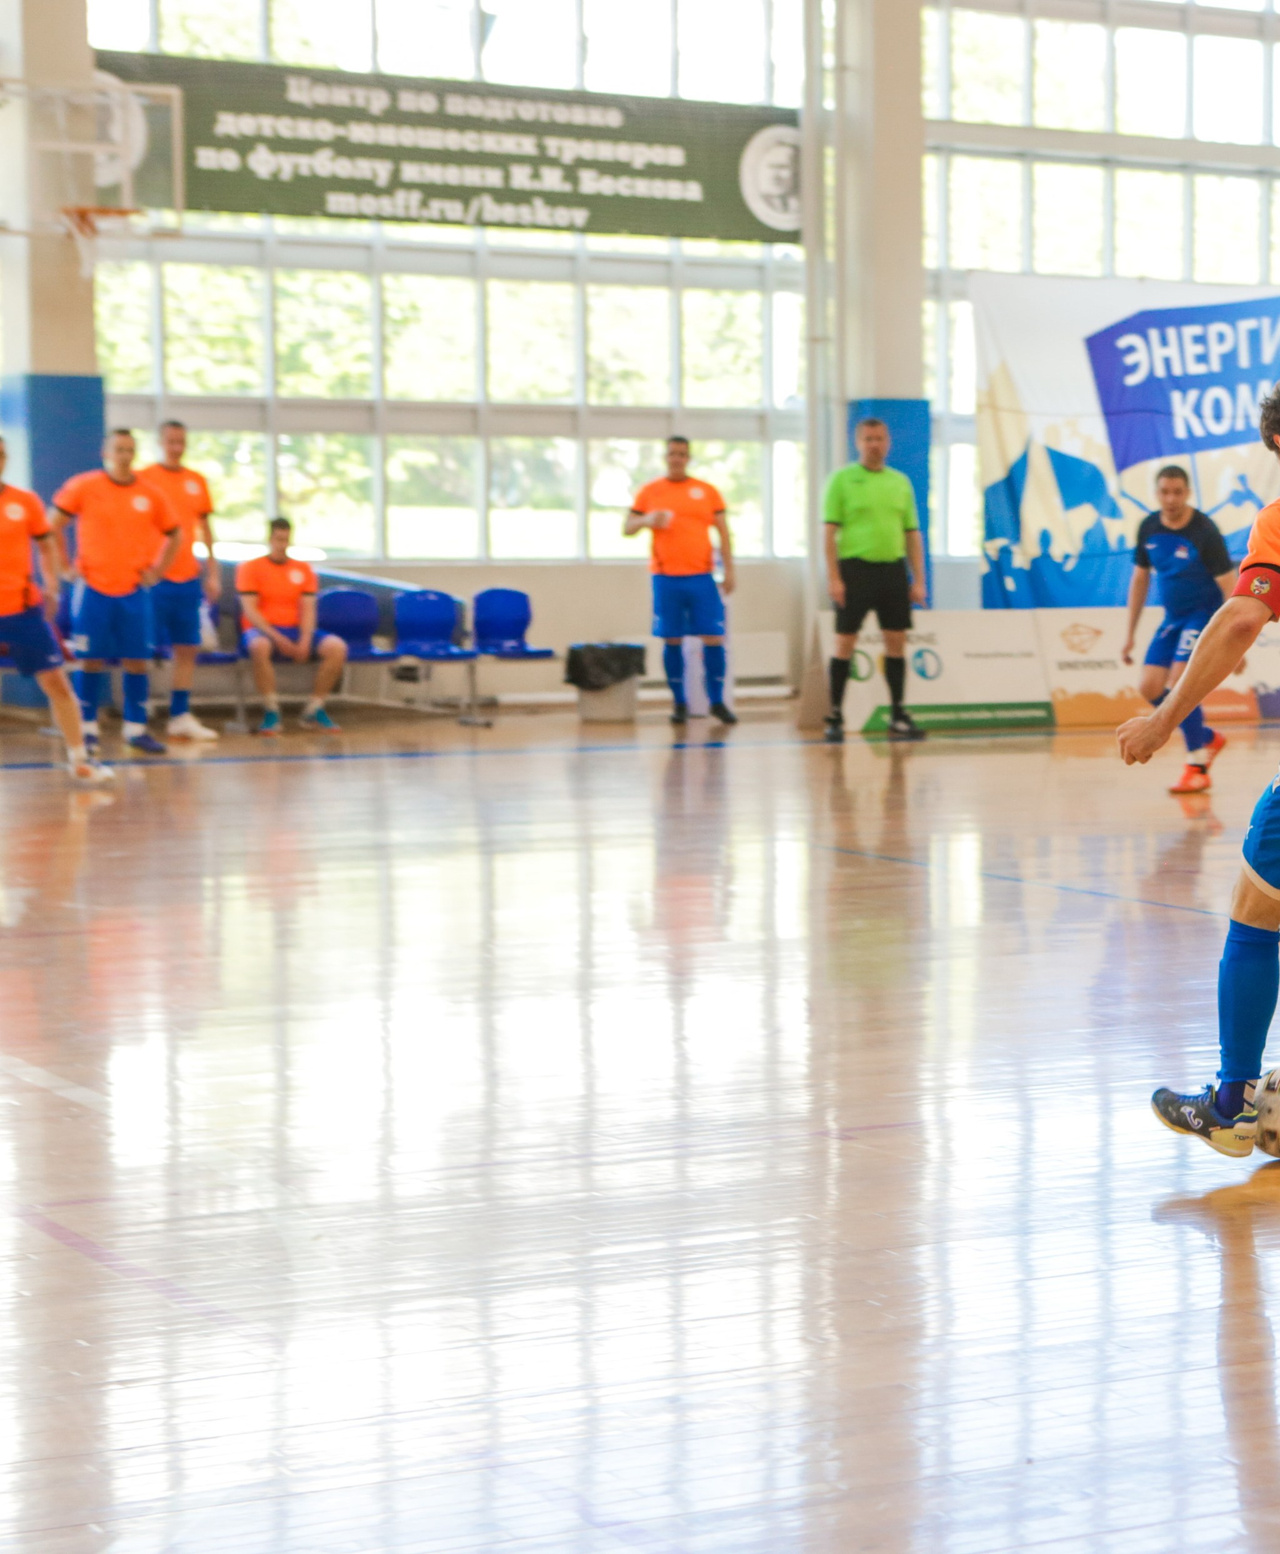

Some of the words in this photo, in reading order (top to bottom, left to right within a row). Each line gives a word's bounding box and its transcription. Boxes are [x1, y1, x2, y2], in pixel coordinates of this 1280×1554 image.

[285, 75, 391, 116] Центр
[397, 88, 440, 114] по
[445, 92, 625, 129] подготовке
[213, 111, 539, 157] детско-юношеских
[542, 134, 686, 170] тренеров
[194, 146, 241, 171] по
[246, 142, 394, 188] футболу
[399, 160, 504, 189] имени
[576, 167, 704, 202] Бескова
[324, 188, 590, 229] mosff.ru/beskov
